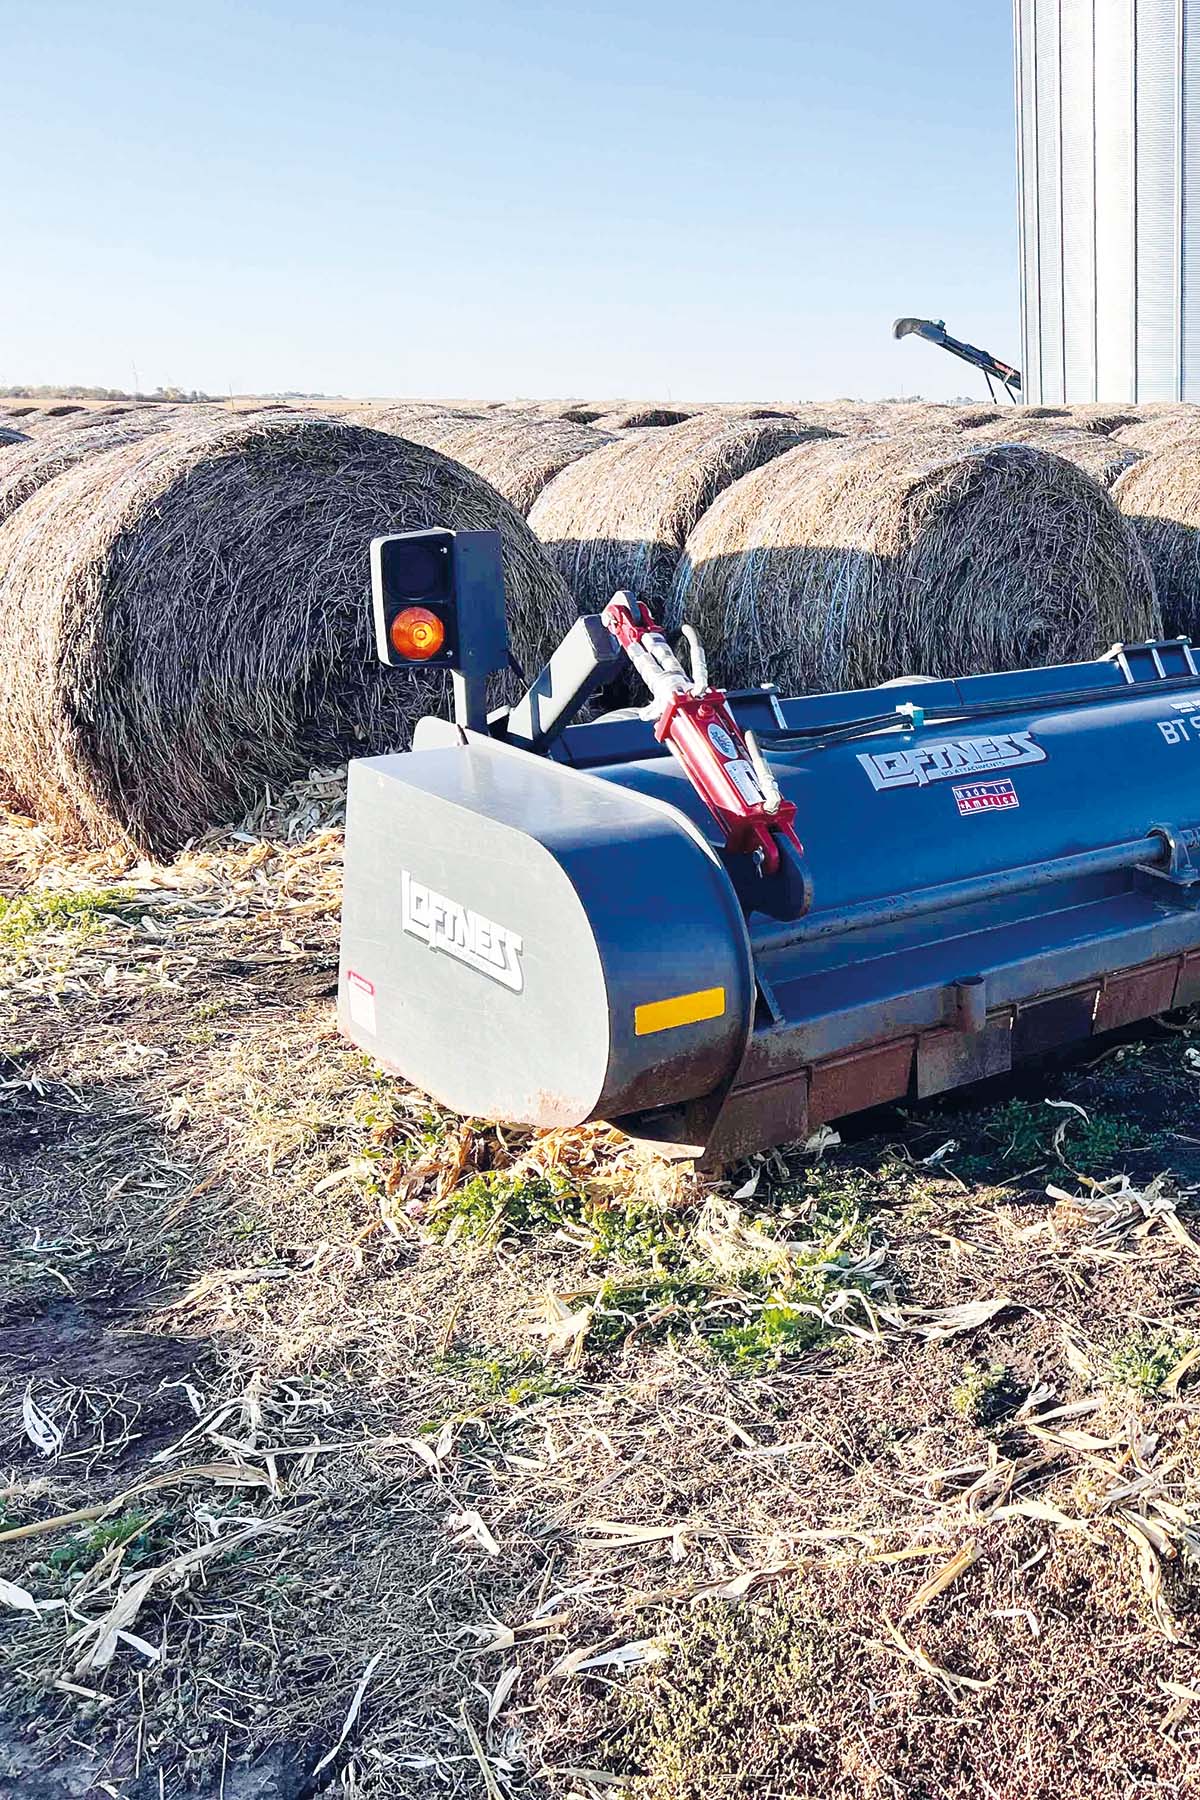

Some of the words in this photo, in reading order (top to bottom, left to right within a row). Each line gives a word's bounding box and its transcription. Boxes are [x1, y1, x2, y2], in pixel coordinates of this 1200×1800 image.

[1157, 721, 1191, 745] BT
[856, 731, 1048, 791] LOFTNESS
[955, 787, 988, 799] Made
[964, 795, 1017, 809] America
